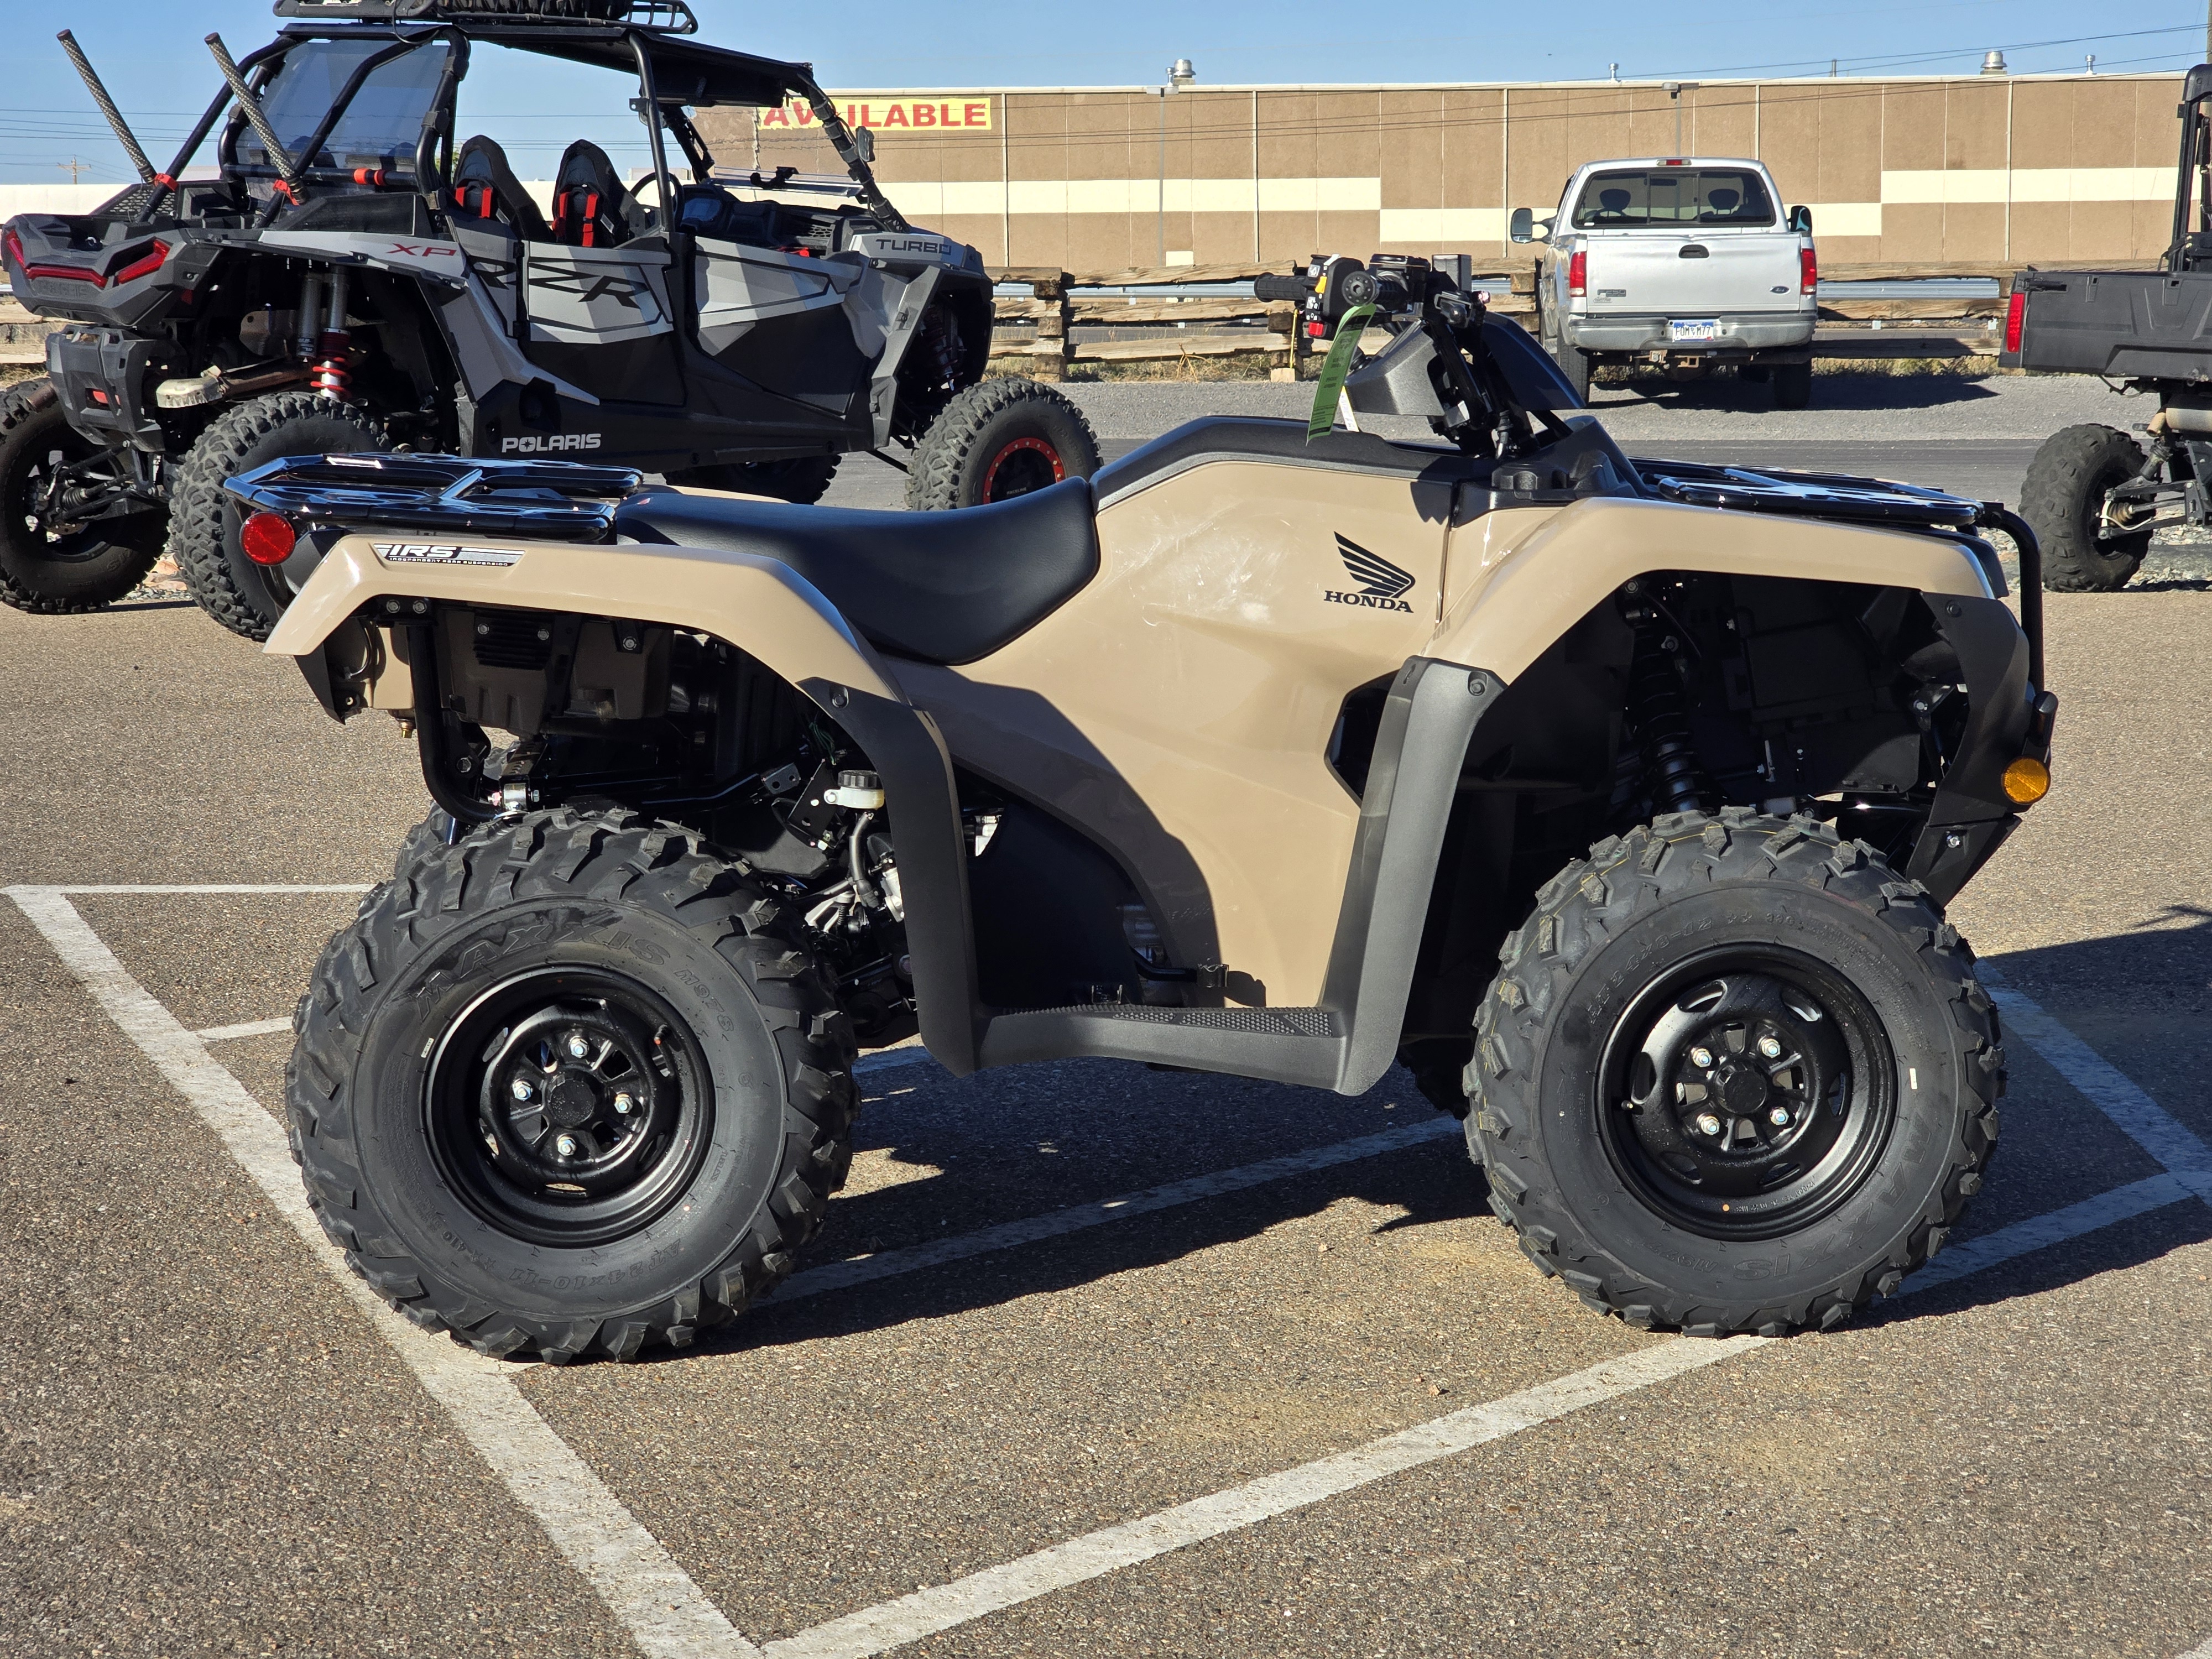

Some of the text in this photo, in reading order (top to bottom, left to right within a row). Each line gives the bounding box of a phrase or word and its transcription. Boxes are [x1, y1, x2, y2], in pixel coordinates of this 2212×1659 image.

[764, 102, 987, 127] AVILABLE
[386, 243, 457, 257] XP
[875, 239, 952, 255] TURBO
[469, 255, 651, 310] RZR
[502, 433, 602, 453] POLARIS
[389, 545, 457, 558] IRS
[1323, 590, 1414, 613] HONDA
[405, 921, 734, 1034] MAXXIS M978
[1732, 1115, 1933, 1280] MAXXIS
